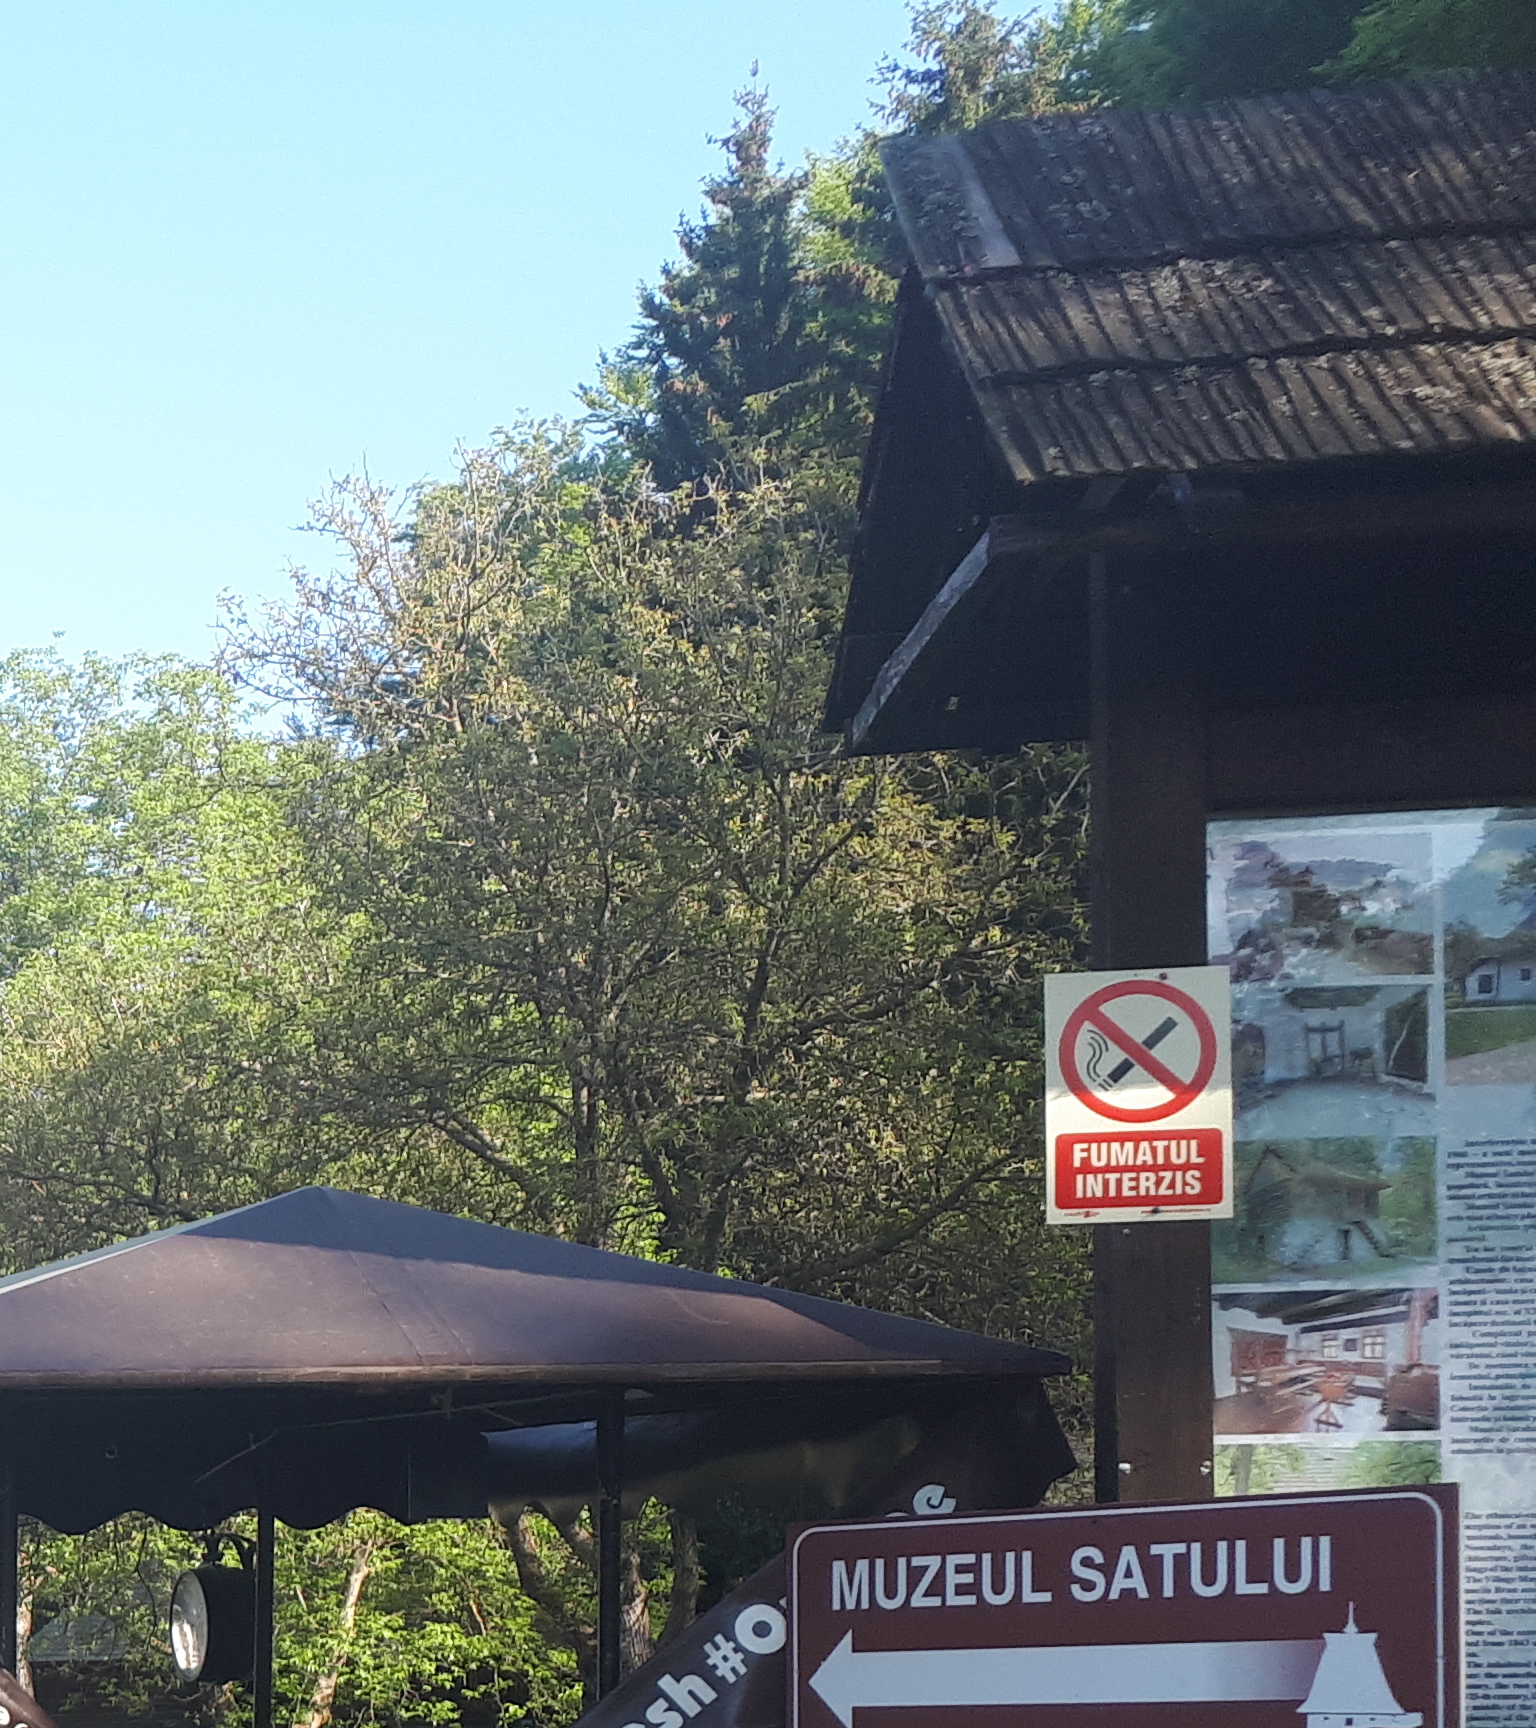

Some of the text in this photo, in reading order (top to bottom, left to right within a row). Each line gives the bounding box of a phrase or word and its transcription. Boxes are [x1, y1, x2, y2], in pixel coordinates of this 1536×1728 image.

[1072, 1138, 1205, 1168] FUMATUL
[1075, 1169, 1202, 1199] INTERZIS
[831, 1534, 1333, 1611] MUZEUL SATULUI
